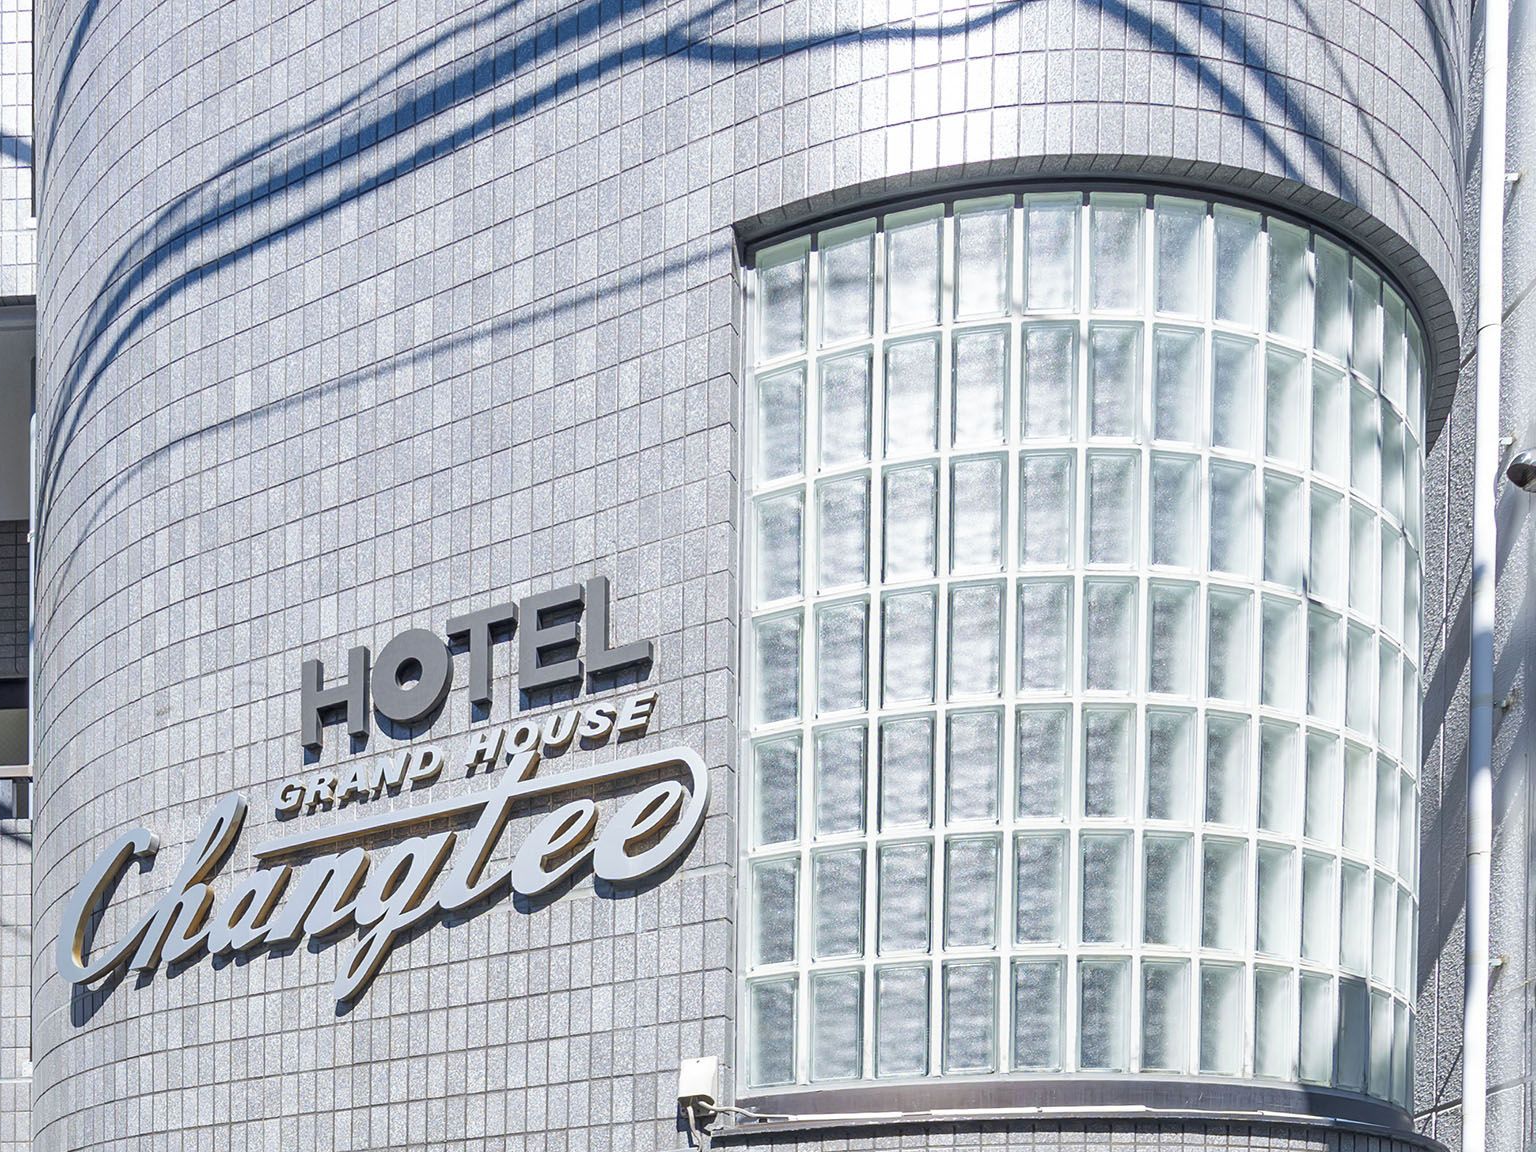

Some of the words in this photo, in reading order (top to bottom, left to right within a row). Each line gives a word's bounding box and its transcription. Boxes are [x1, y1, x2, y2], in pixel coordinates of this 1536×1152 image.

[300, 575, 654, 750] HOTEL
[274, 745, 446, 813] GRAND
[466, 690, 659, 769] HOUSE
[56, 745, 713, 1002] Changtee
